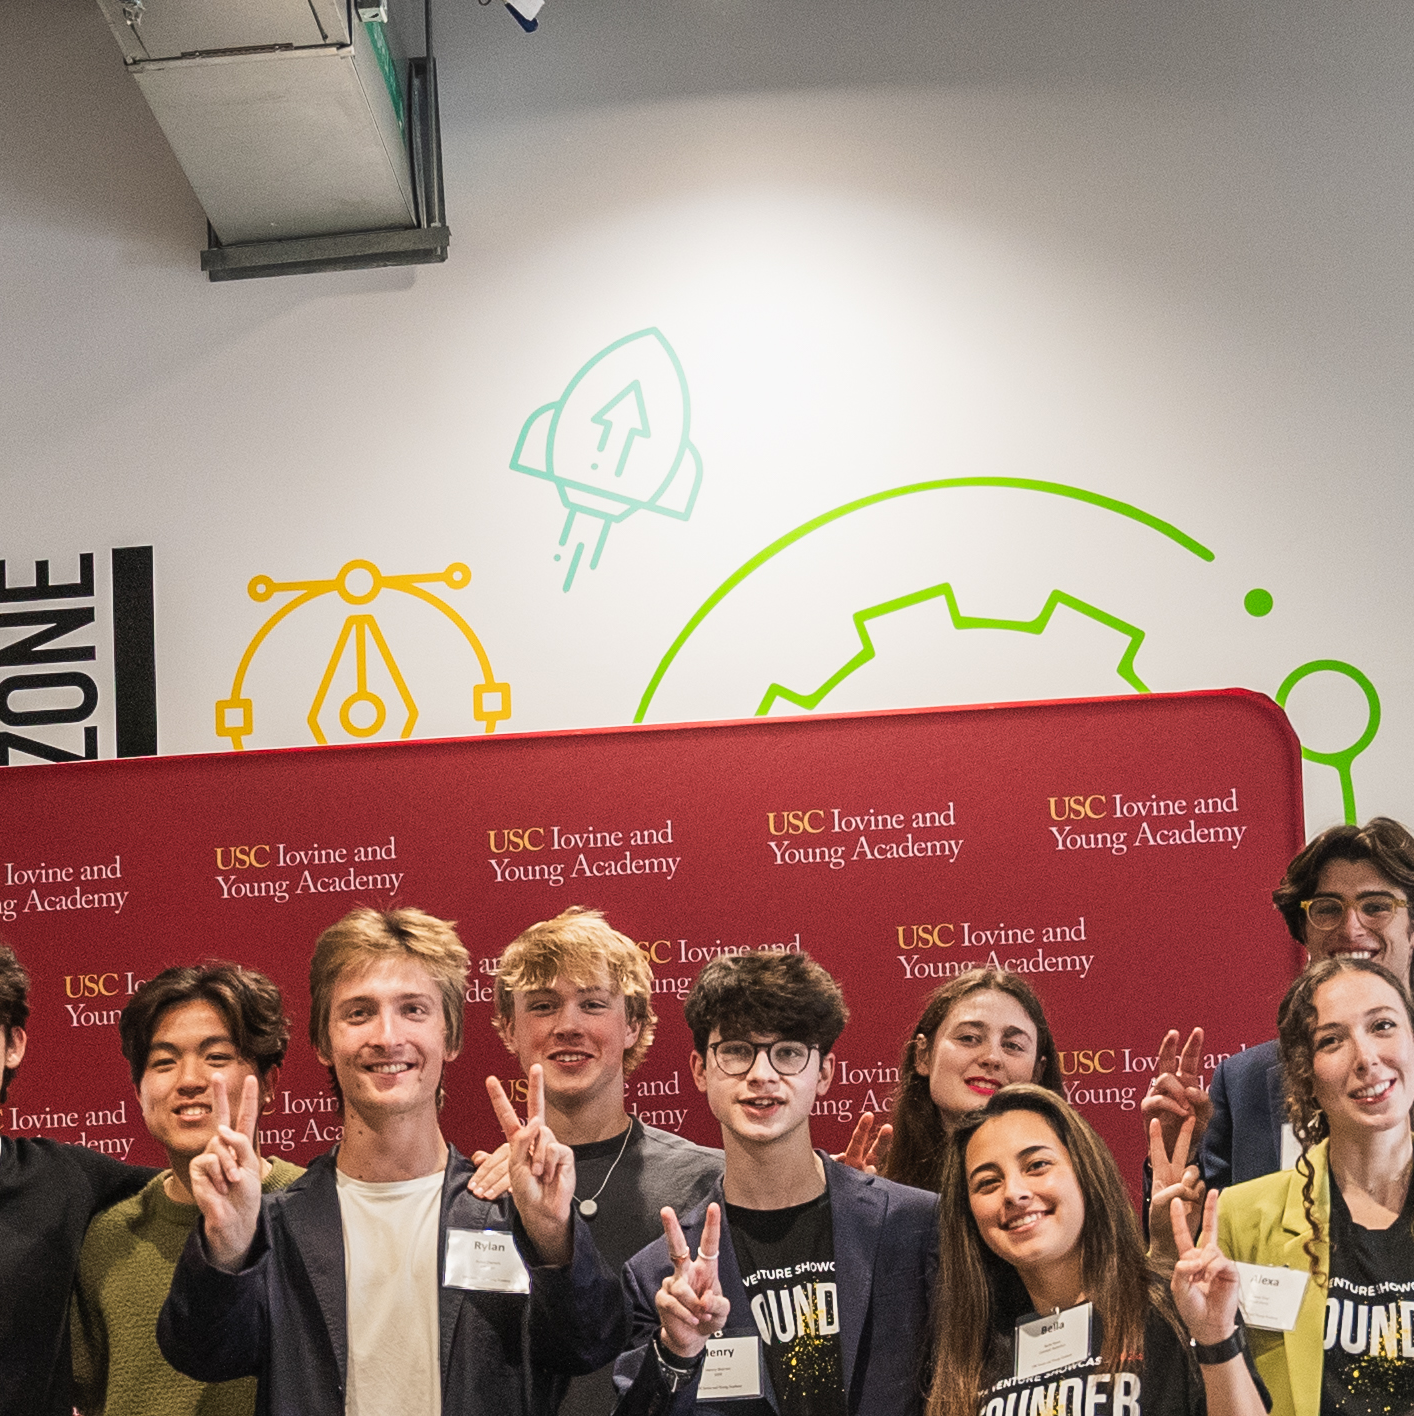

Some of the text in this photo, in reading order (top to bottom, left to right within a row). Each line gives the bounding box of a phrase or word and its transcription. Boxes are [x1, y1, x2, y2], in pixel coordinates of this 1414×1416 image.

[1047, 788, 1239, 821] USC Iovine and
[767, 802, 956, 836] USC Iovine and
[487, 820, 674, 854] USC Iovine and
[1048, 820, 1247, 856] Young Academy
[214, 836, 397, 871] USC Iovine and
[767, 834, 964, 870] Young Academy
[4, 862, 74, 887] Iovine
[79, 855, 122, 881] and
[487, 851, 682, 887] Young Academy
[22, 886, 130, 914] Academy
[214, 868, 404, 904] Young Academy
[896, 917, 1087, 950] USC Iovine and
[638, 939, 673, 964] SC
[984, 949, 1095, 978] Academy
[64, 972, 119, 998] USC
[651, 976, 692, 998] ung
[65, 1003, 122, 1028] Youn
[837, 1060, 900, 1085] Iovin
[1057, 1049, 1116, 1076] USC
[637, 1072, 681, 1097] and
[1062, 1080, 1136, 1111] Young
[8, 1100, 128, 1131] Iovine and
[281, 1091, 337, 1115] Iovin
[810, 1099, 853, 1123] ung
[474, 1240, 506, 1252] Rylan
[794, 1261, 836, 1275] SHOWC
[1250, 1274, 1280, 1287] Alexa
[750, 1282, 841, 1346] OUND
[1040, 1321, 1065, 1335] Bella
